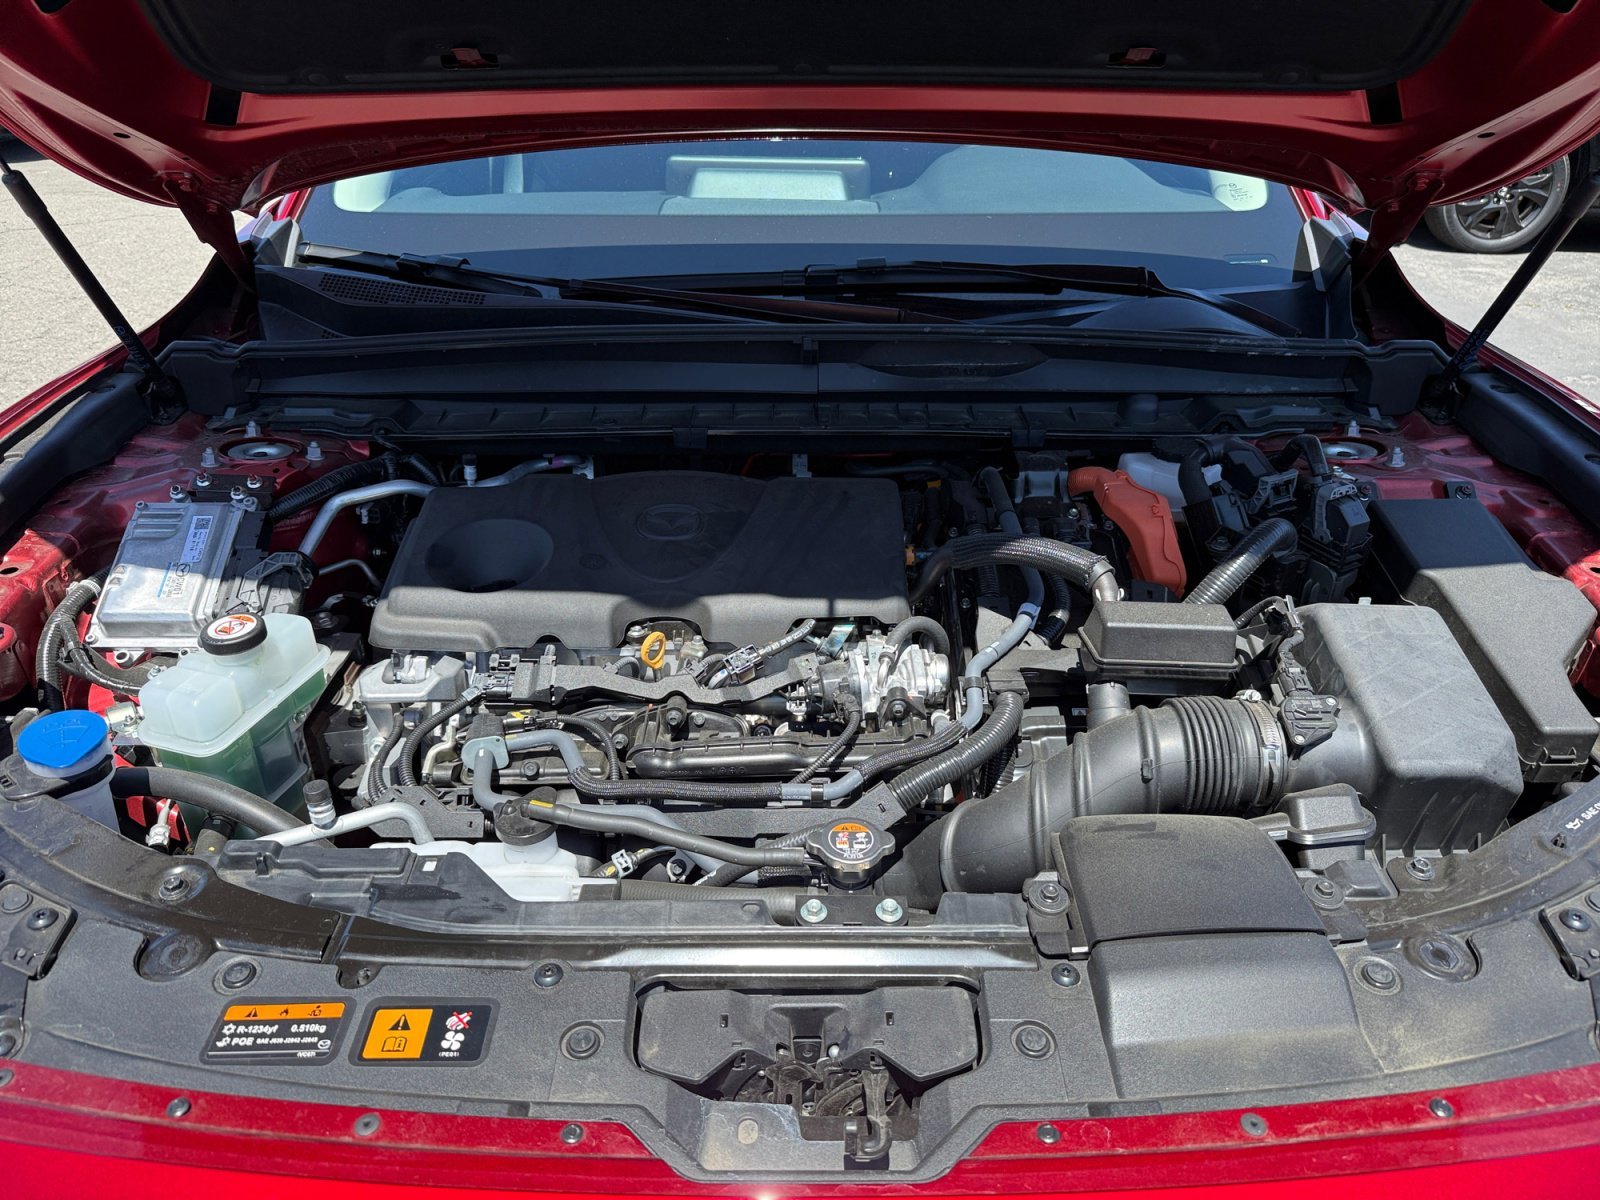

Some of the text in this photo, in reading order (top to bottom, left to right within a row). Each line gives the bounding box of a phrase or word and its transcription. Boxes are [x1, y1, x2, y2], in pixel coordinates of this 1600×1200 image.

[236, 1023, 327, 1035] R-1234yf 0.510kg
[231, 1037, 254, 1047] POE
